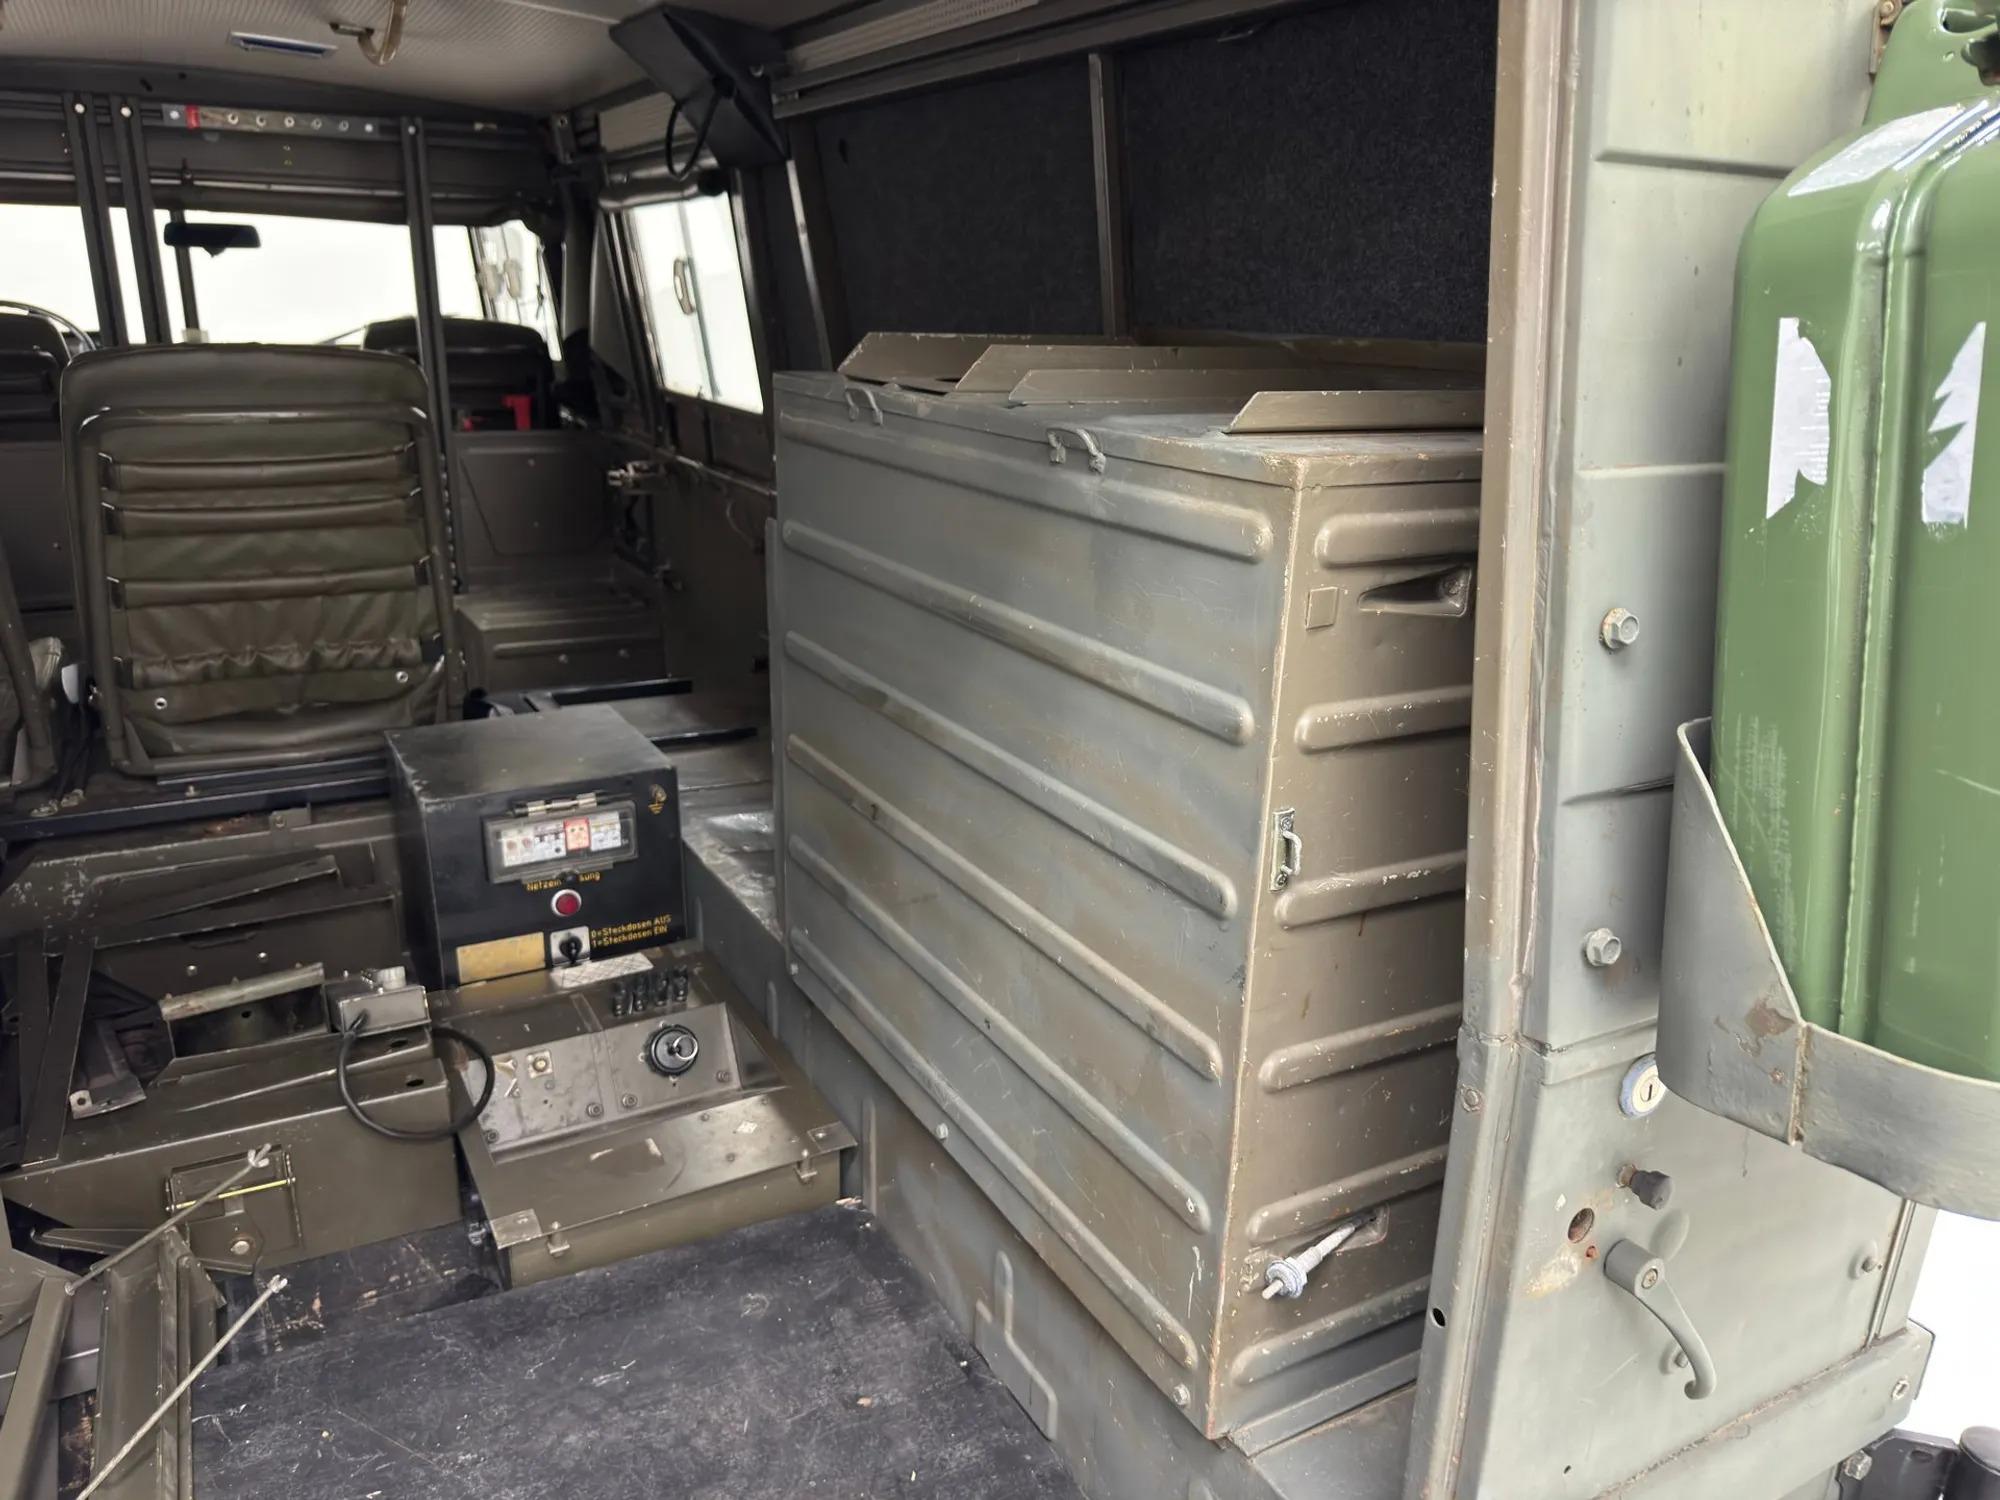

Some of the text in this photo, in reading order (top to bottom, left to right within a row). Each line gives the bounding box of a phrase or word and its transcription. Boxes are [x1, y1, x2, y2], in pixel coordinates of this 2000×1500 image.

[526, 872, 600, 891] Netzeinsung
[654, 914, 672, 925] AUS
[654, 925, 668, 936] EIN
